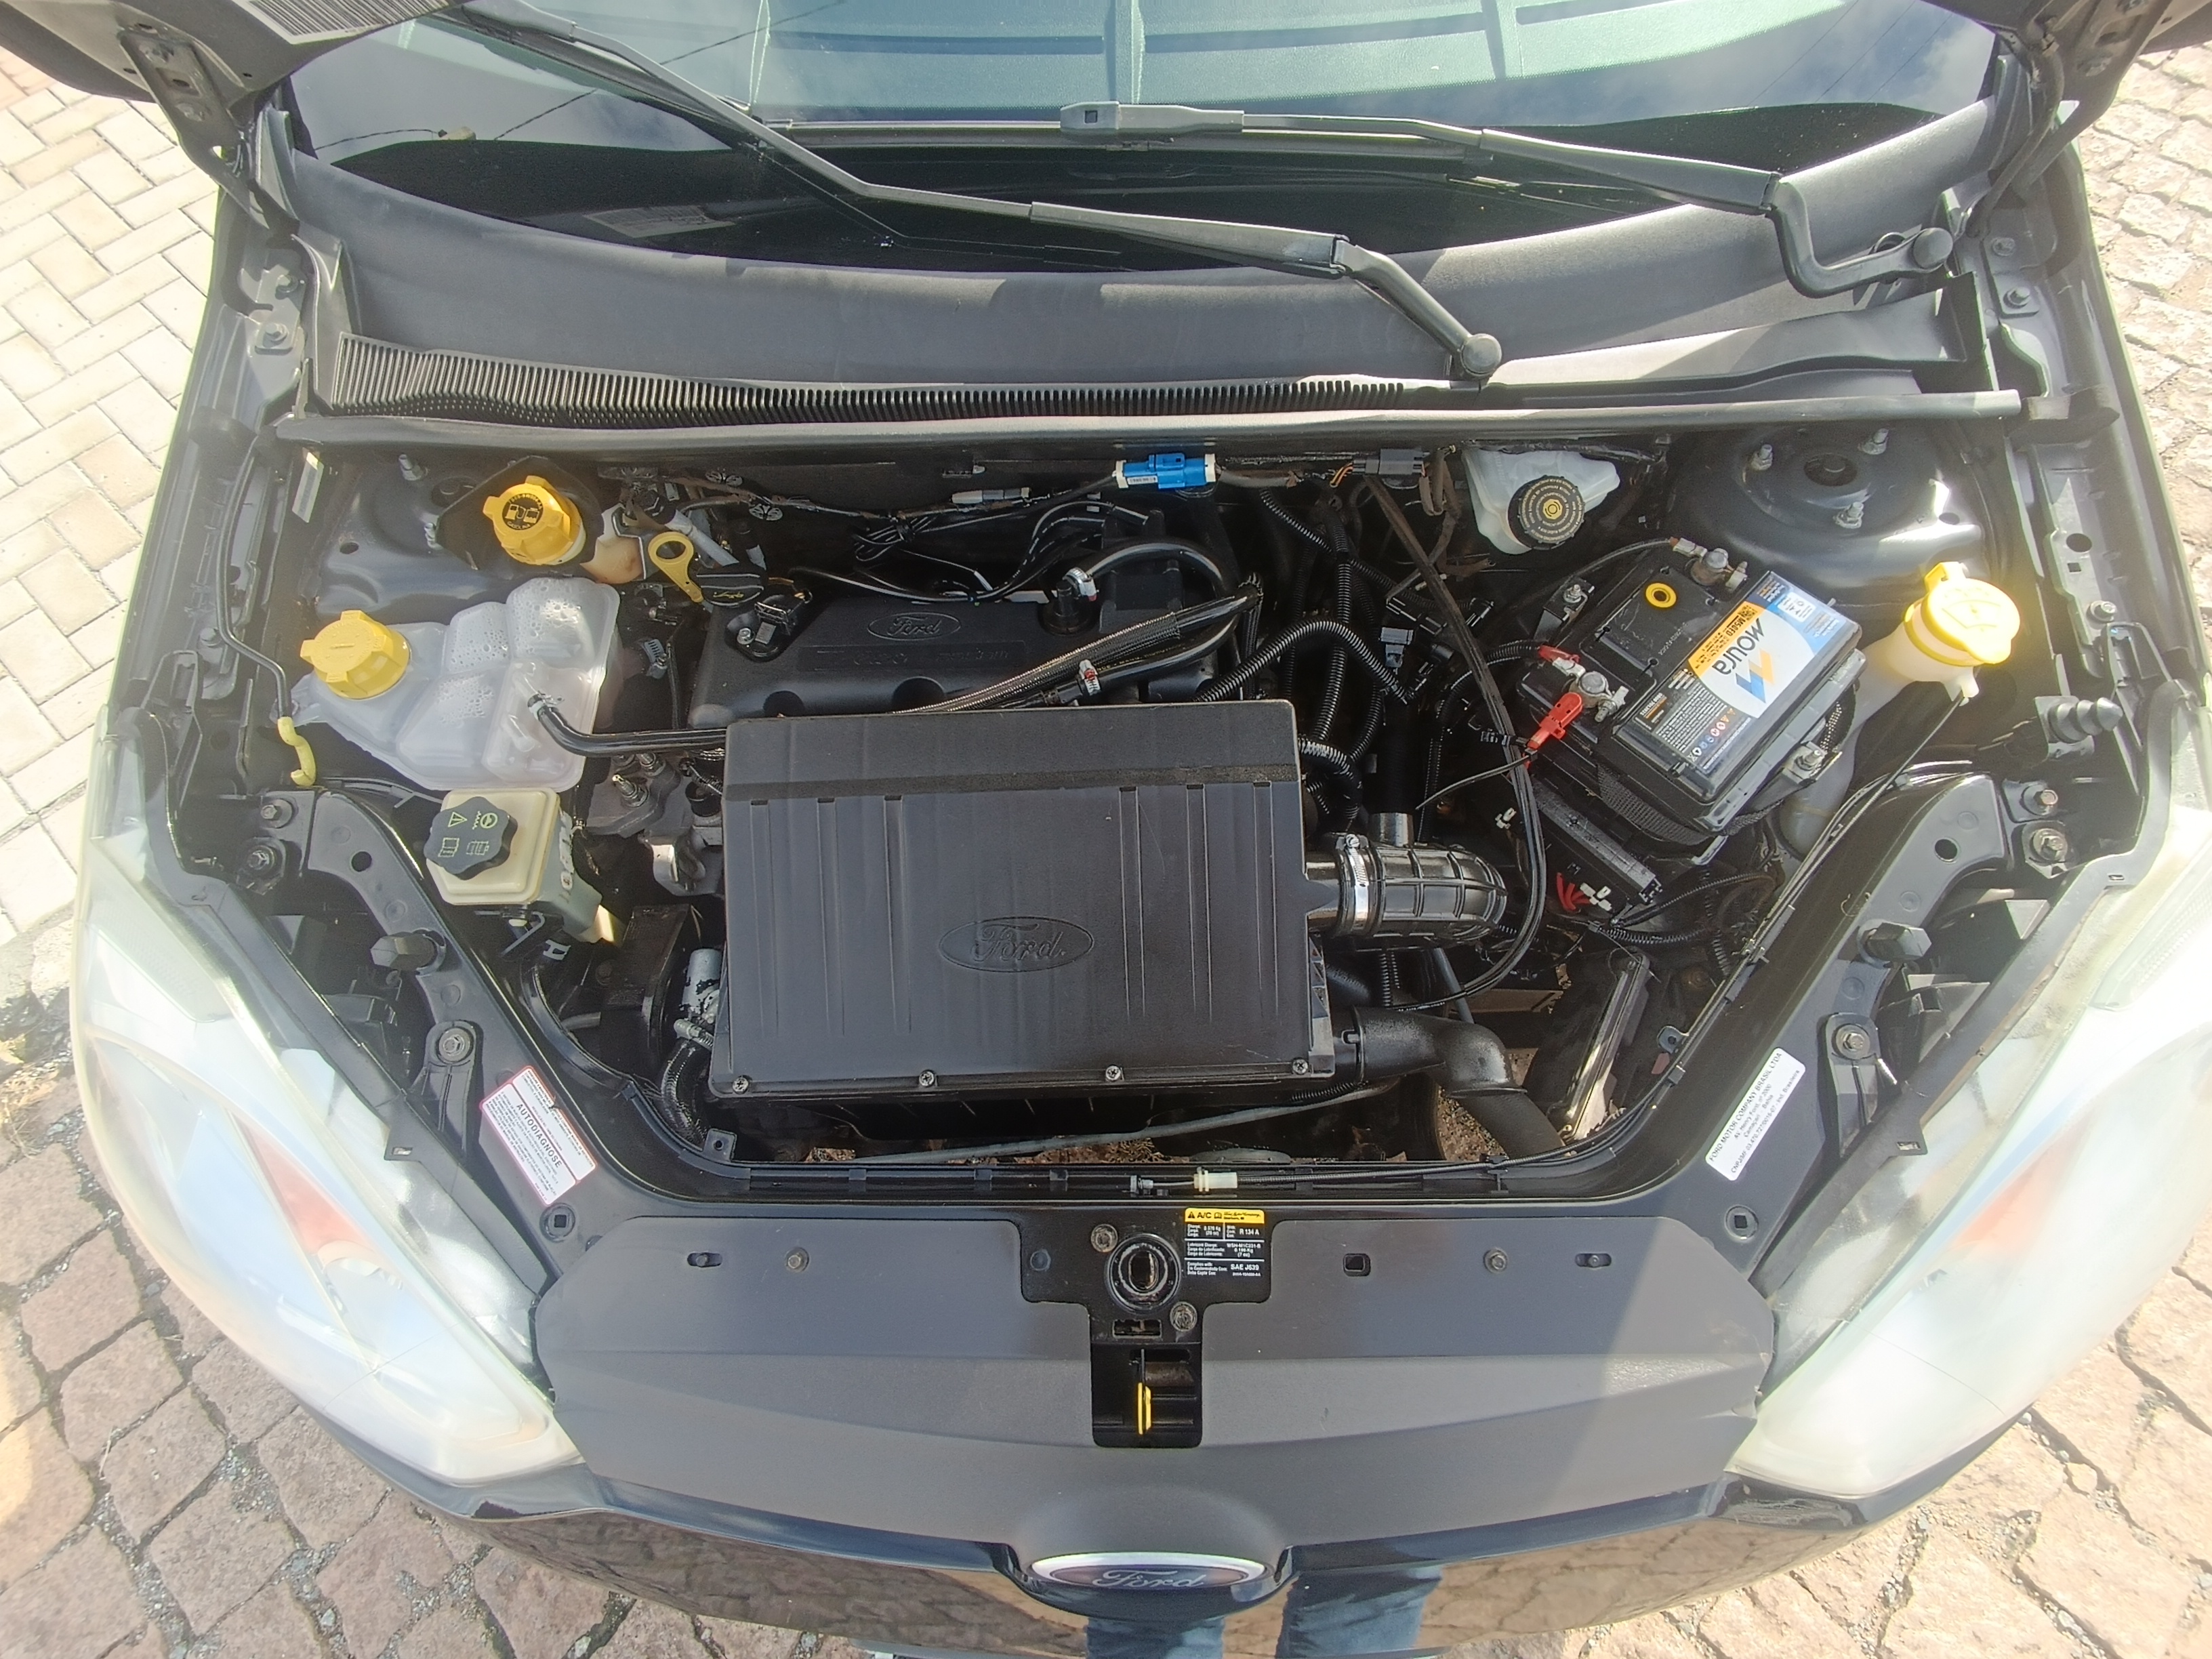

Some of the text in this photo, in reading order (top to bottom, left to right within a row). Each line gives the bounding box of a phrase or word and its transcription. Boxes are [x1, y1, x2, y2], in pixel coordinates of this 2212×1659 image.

[887, 616, 942, 636] Ford
[970, 922, 1063, 962] Ford
[1782, 1068, 1800, 1093] Brasileira
[1708, 1051, 1782, 1162] FORD MOTOR COMPANY BRASIL LTDA
[1738, 1115, 1753, 1132] Henry
[1760, 1082, 1772, 1097] 2000
[1761, 1093, 1774, 1109] Bahia
[515, 1103, 562, 1168] AUTODIAGNOSE
[1092, 1569, 1206, 1589] Ford
